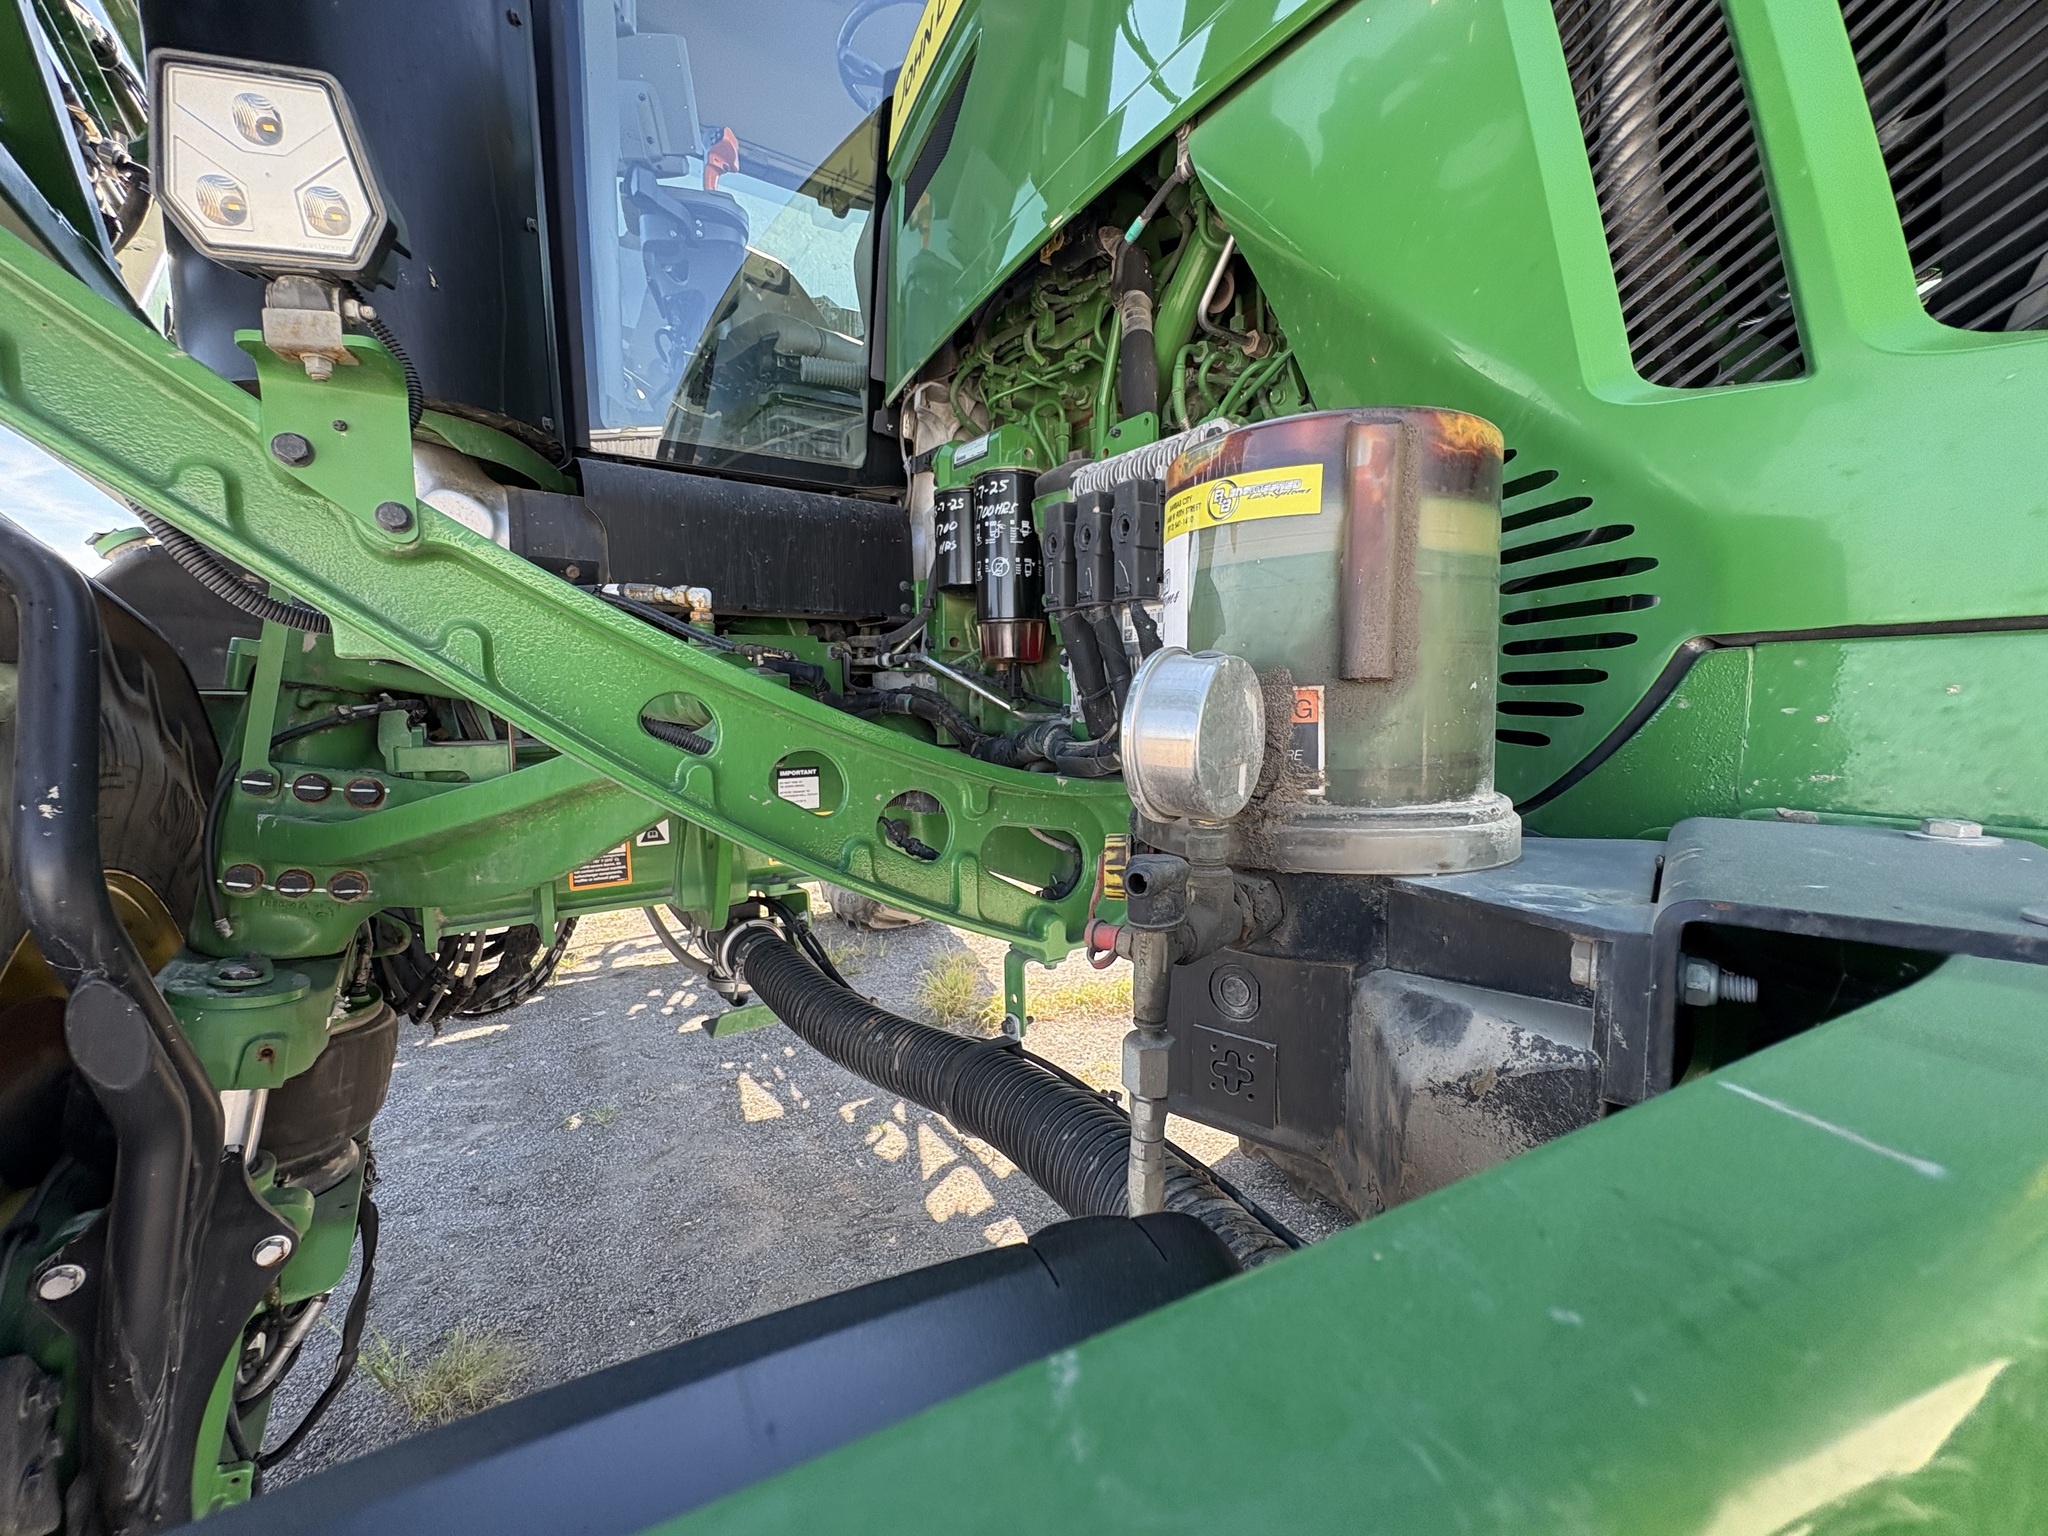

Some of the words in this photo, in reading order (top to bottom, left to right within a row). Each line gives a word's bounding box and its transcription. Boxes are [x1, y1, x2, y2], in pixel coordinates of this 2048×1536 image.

[897, 13, 935, 117] JOHN
[938, 540, 958, 555] HRS
[779, 768, 817, 777] IMPORTANT
